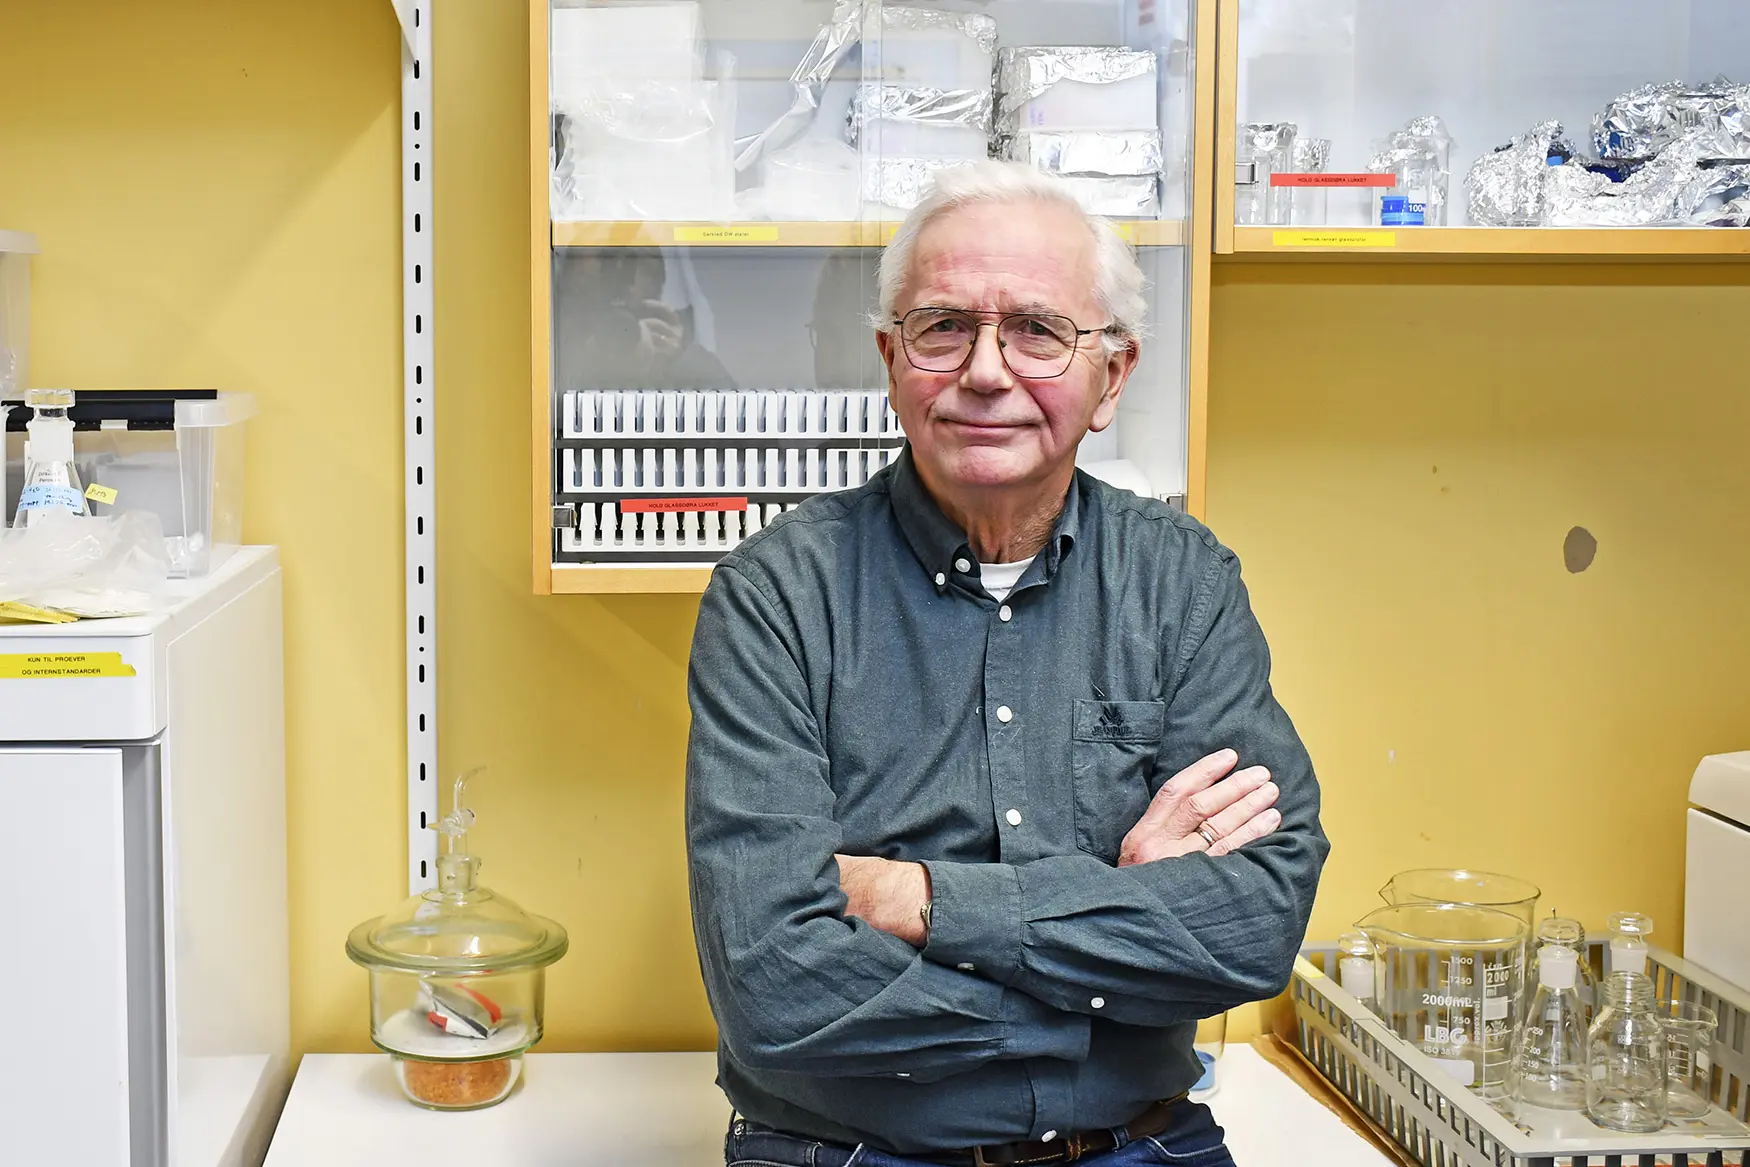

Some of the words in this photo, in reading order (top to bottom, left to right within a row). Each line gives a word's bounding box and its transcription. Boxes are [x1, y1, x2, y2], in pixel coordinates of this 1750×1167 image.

[1450, 956, 1473, 965] 1500
[1449, 976, 1472, 985] 1250
[1452, 1016, 1471, 1025] 750
[1424, 1024, 1468, 1045] LBG
[1424, 1045, 1439, 1054] ISO
